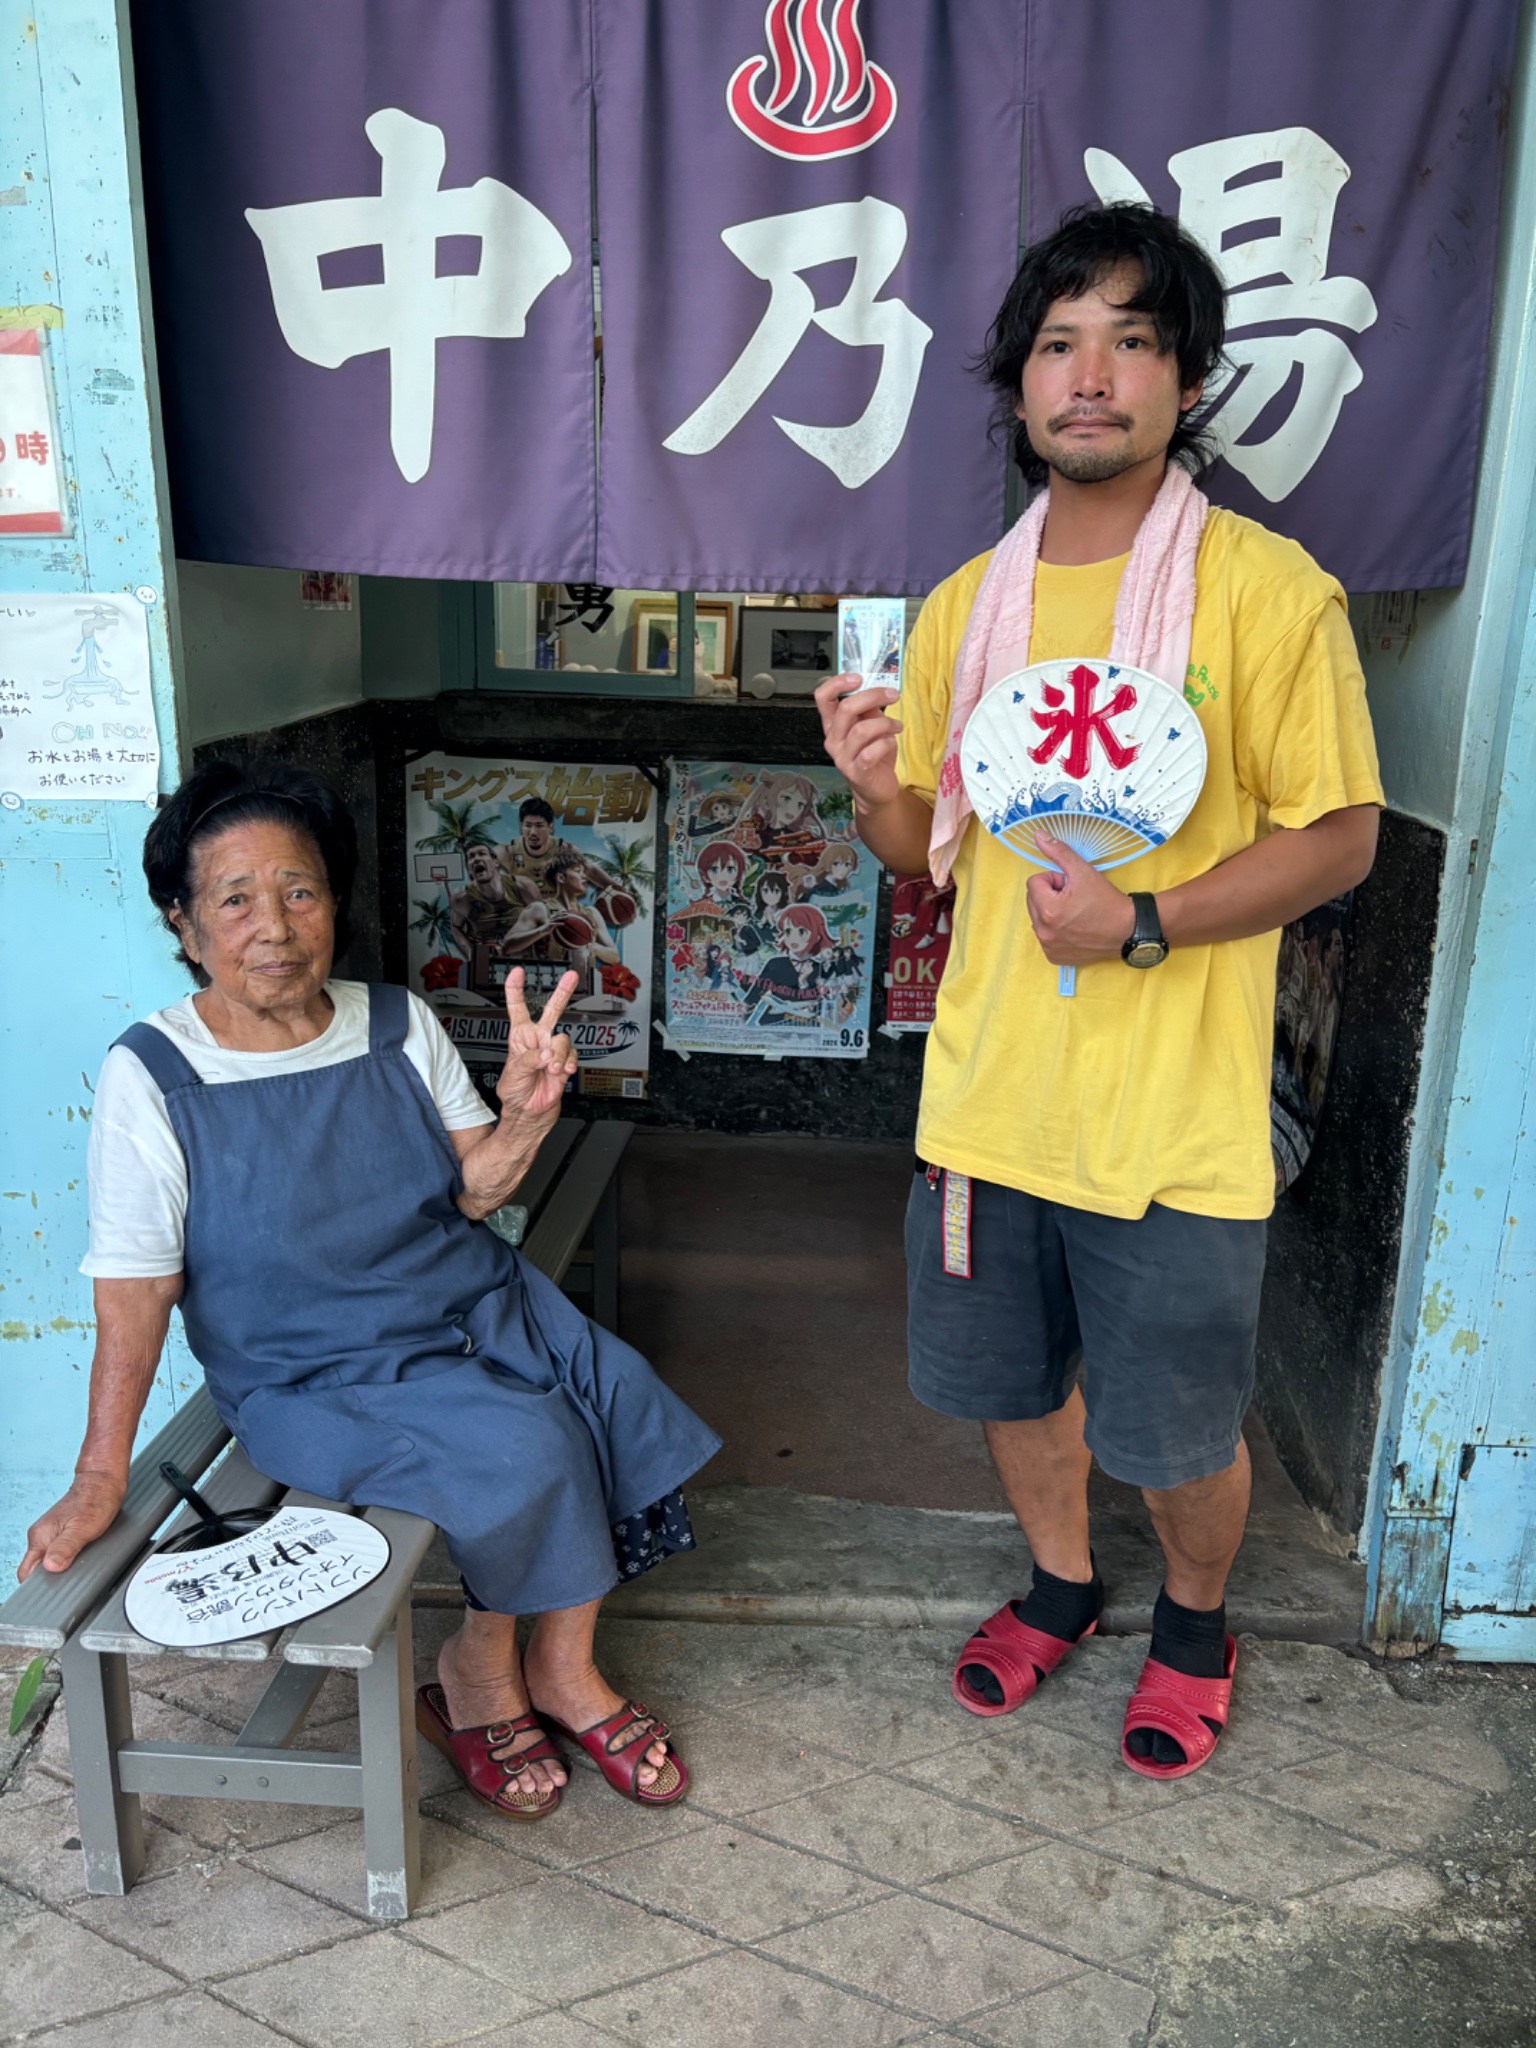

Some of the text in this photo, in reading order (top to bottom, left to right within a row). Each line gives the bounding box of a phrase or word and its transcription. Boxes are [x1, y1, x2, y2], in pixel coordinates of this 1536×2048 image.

[244, 108, 1378, 502] 中乃湯
[52, 722, 94, 743] OH
[1027, 664, 1143, 779] 氷
[39, 773, 126, 787] お使いください
[411, 766, 652, 826] キングス始動
[451, 1017, 510, 1040] ISLAND
[574, 1024, 616, 1047] 2025
[840, 1028, 864, 1047] 9.6
[186, 1553, 355, 1624] イオンタウン読谷
[242, 1566, 371, 1624] ソフトバンク
